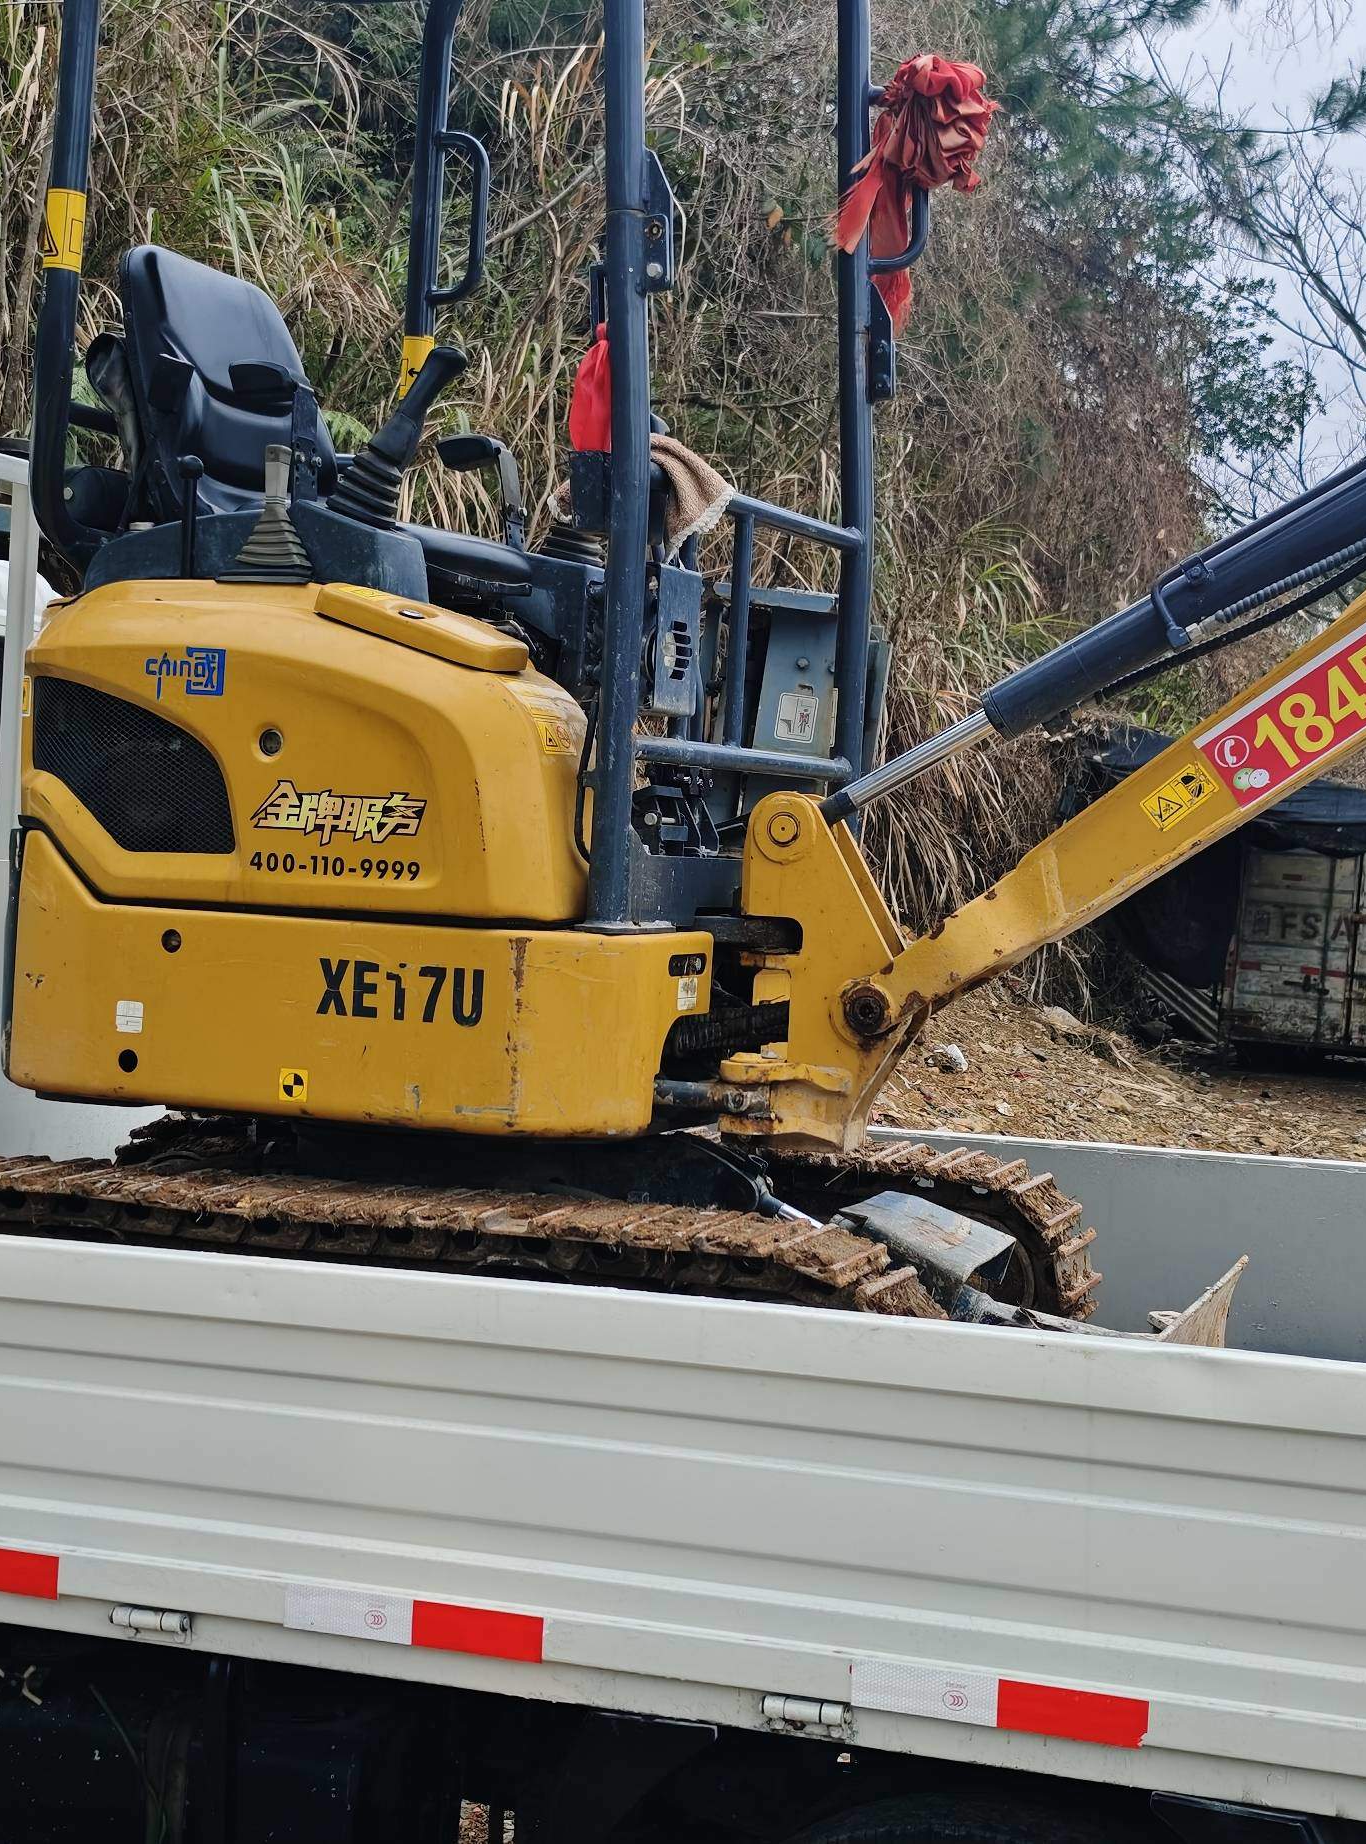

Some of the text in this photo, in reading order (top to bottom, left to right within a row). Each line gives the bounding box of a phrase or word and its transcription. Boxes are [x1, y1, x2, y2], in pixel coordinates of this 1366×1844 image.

[250, 780, 427, 847] 金牌服务
[249, 851, 421, 881] 400-110-9999
[316, 957, 485, 1028] XE17U
